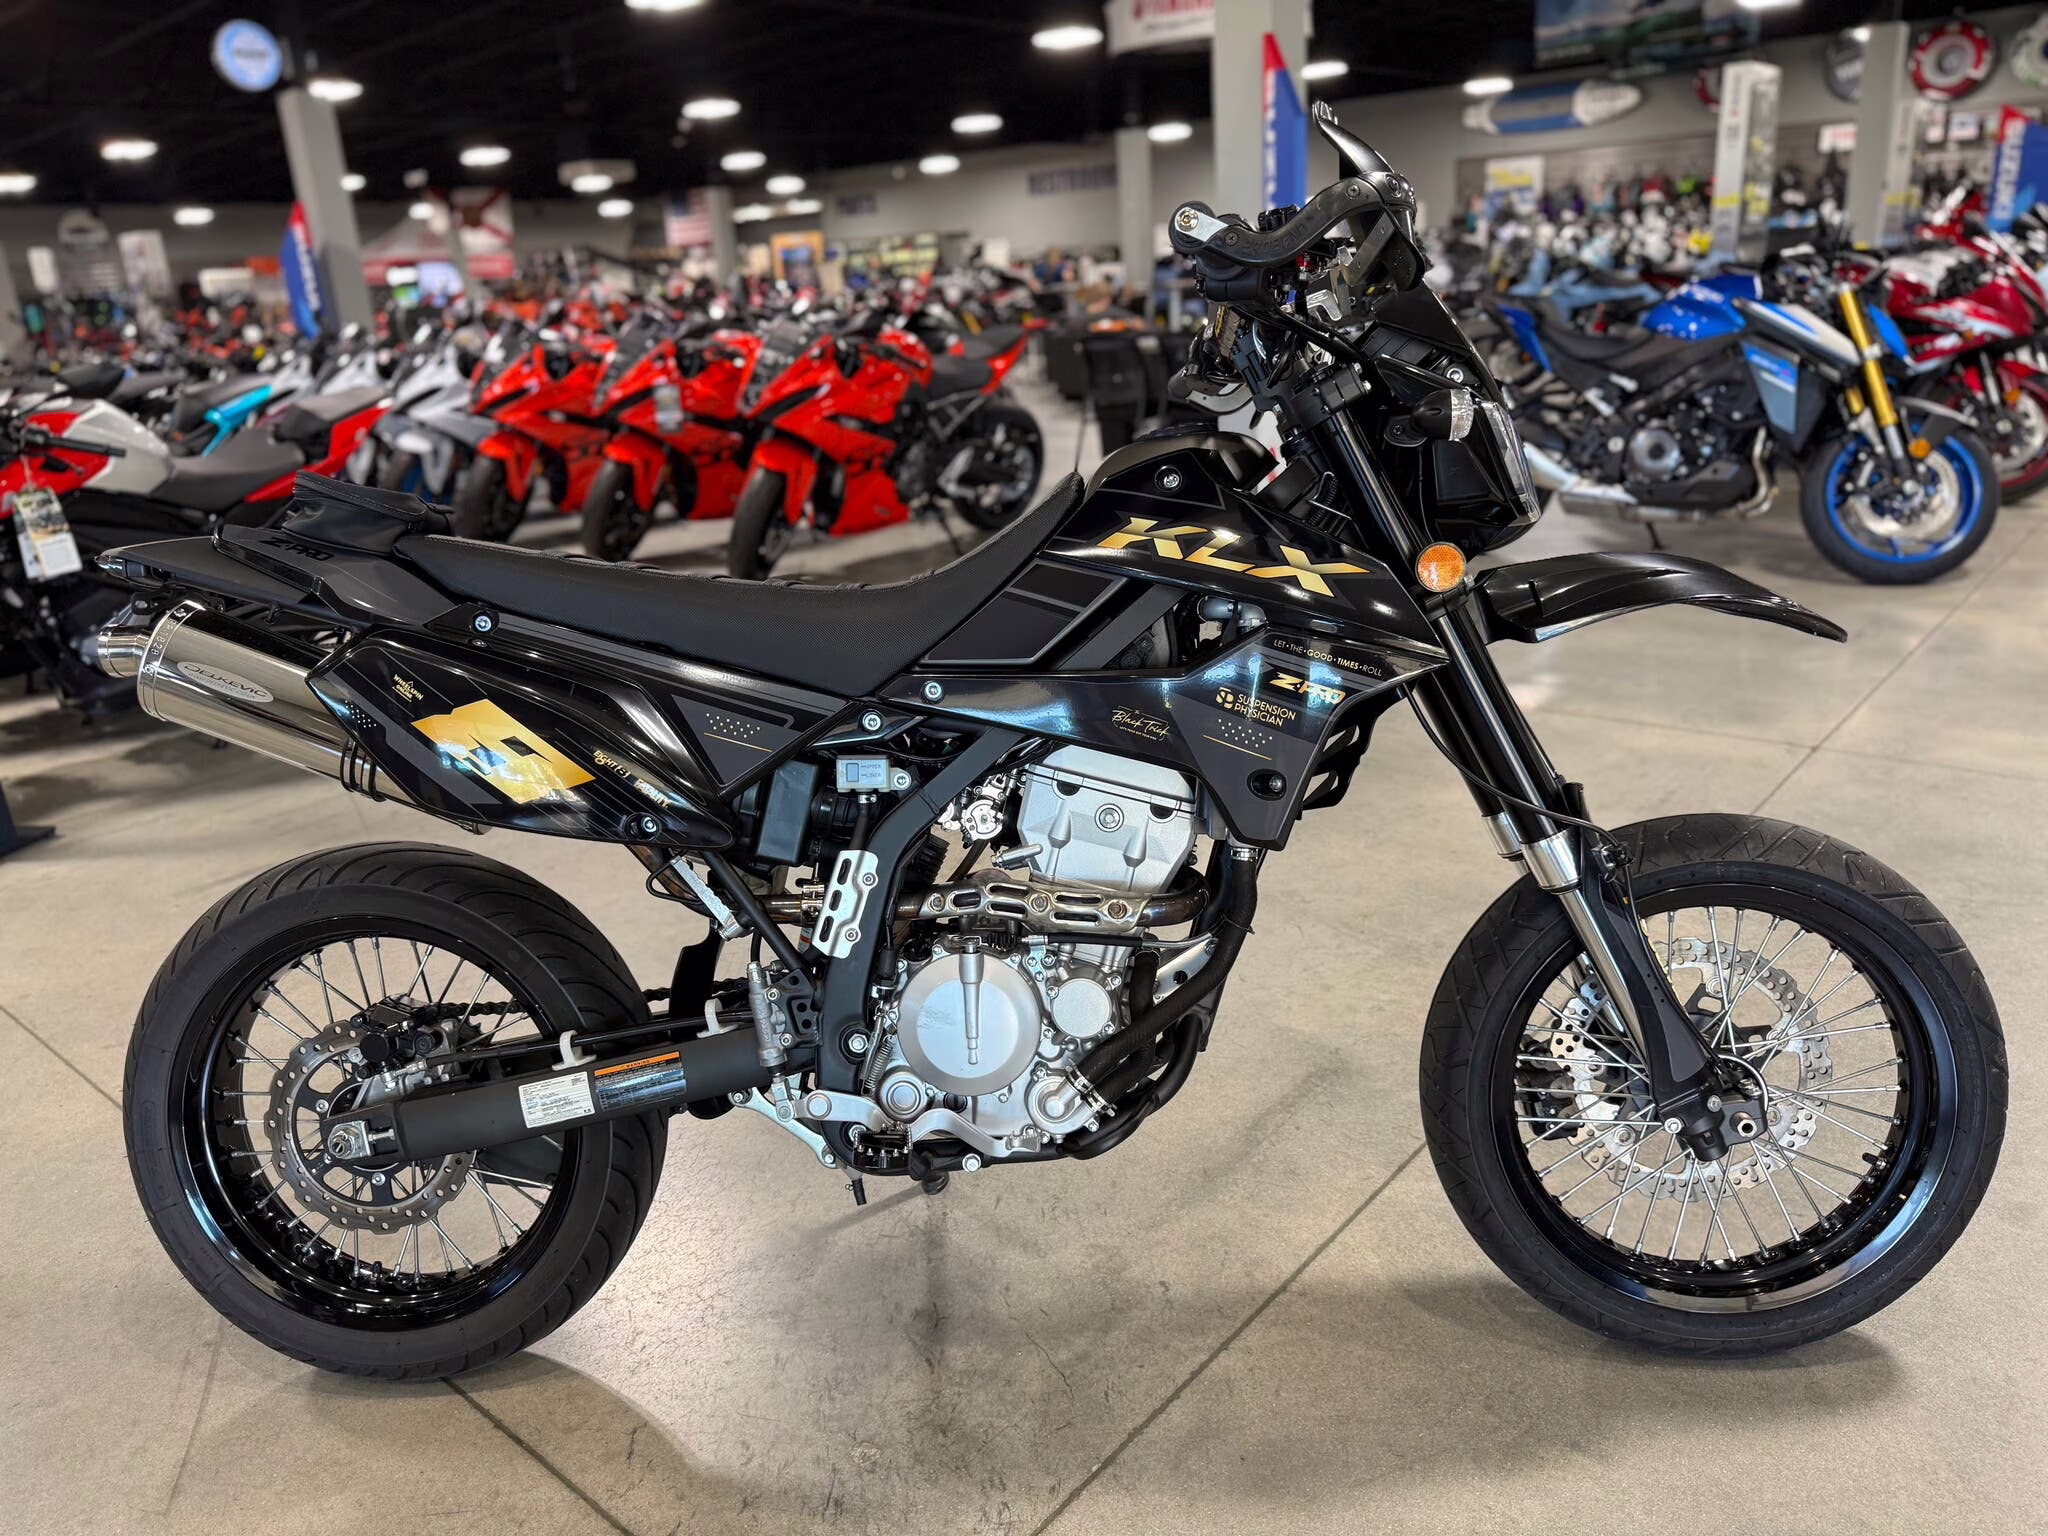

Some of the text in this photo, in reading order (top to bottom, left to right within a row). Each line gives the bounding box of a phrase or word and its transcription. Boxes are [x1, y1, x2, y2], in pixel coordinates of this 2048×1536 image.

[1097, 516, 1371, 598] KLX
[1307, 649, 1333, 662] GOOD
[1337, 656, 1359, 670] TIMES
[1362, 664, 1382, 677] ROLL
[393, 673, 424, 701] WHEELSPIN
[1233, 703, 1284, 727] PHYSICIAN
[1237, 693, 1297, 721] SUSPENSION
[1112, 709, 1145, 728] Black
[1143, 719, 1170, 737] Trick
